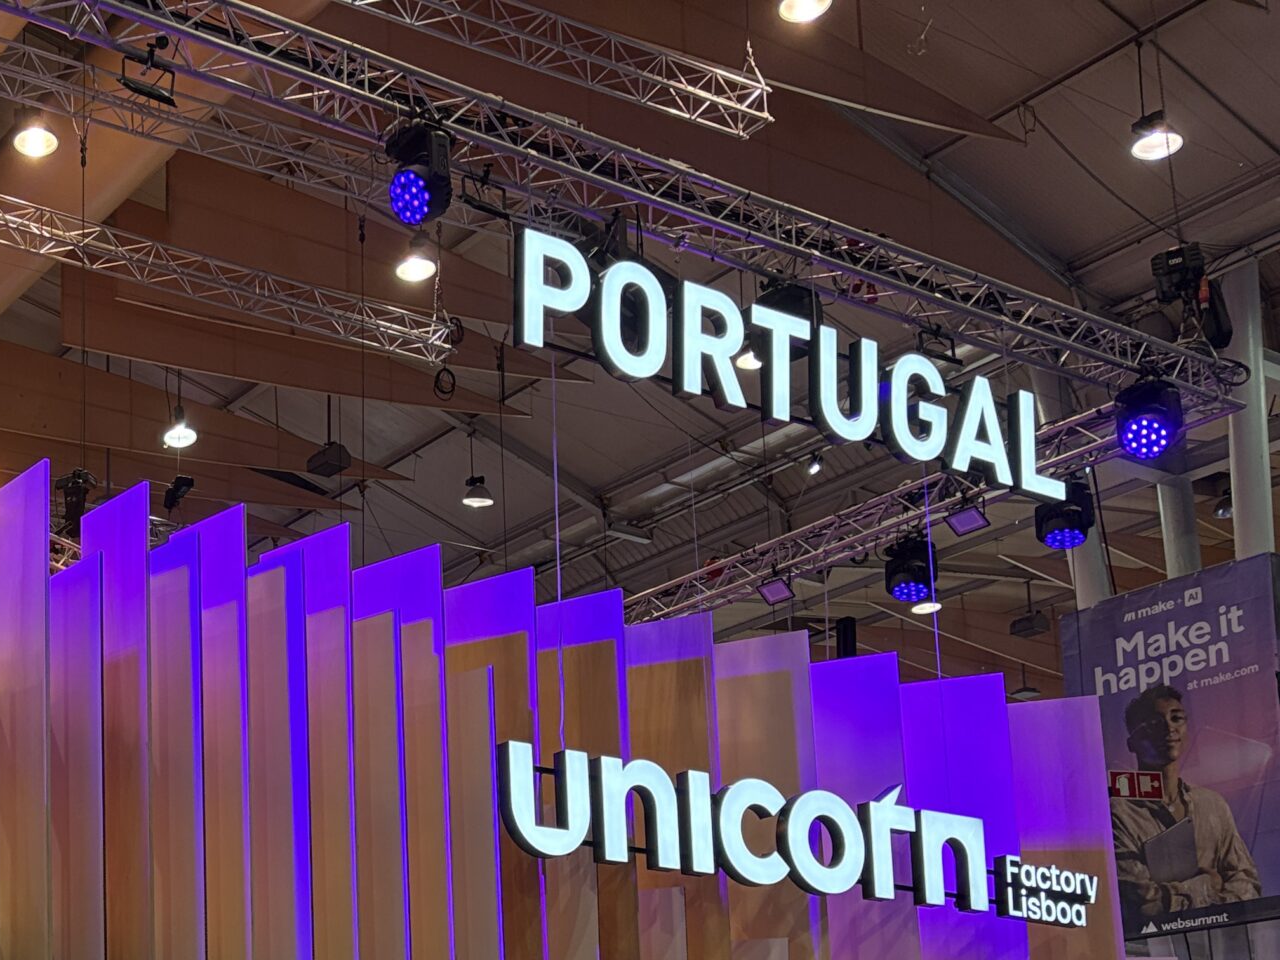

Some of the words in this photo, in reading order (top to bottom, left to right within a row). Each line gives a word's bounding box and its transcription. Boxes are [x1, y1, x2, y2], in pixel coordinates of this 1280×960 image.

[523, 228, 1066, 501] PORTUGAL
[1137, 599, 1175, 618] make
[1115, 621, 1212, 667] Make
[1218, 605, 1246, 637] it
[1094, 641, 1230, 697] happen
[1186, 681, 1199, 690] at
[1200, 663, 1260, 688] make.com
[507, 740, 990, 912] unicorn
[1006, 856, 1098, 905] Factory
[1008, 886, 1087, 929] Lisboa
[1161, 912, 1229, 931] websummit
